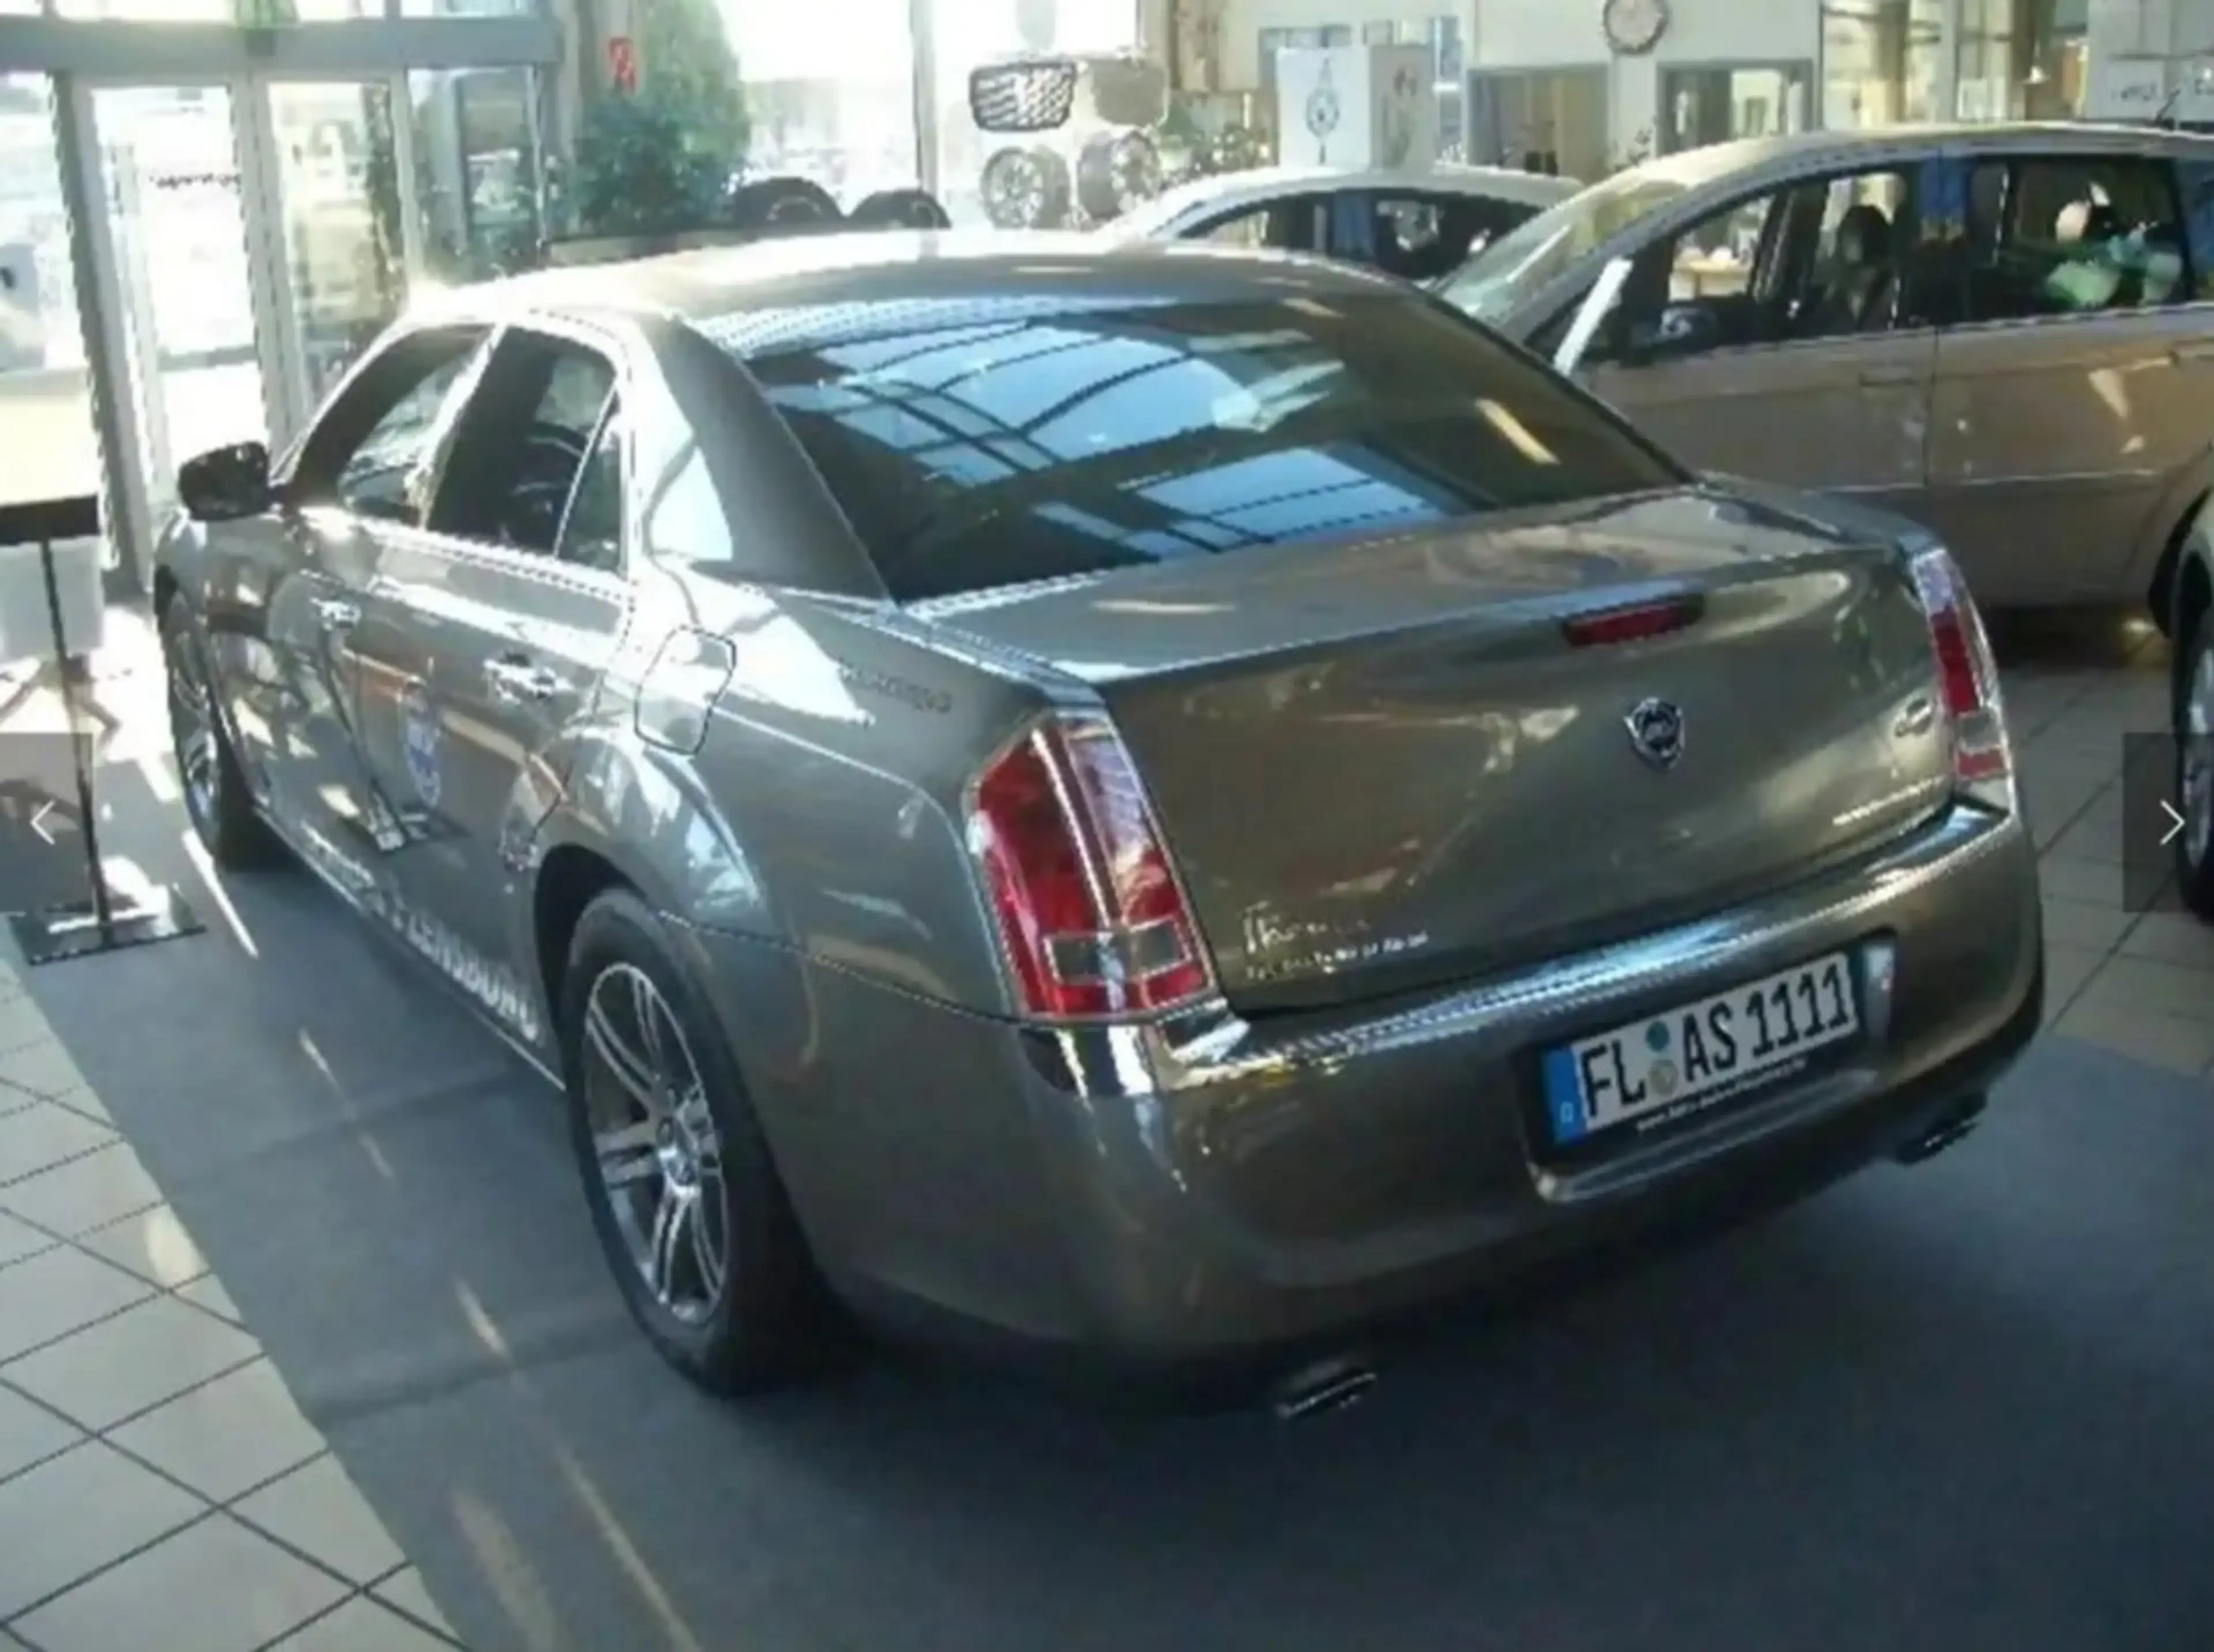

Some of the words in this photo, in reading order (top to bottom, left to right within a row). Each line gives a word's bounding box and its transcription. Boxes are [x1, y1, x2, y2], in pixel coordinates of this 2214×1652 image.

[1580, 1040, 1646, 1117] FL
[1682, 1000, 1737, 1082] AS
[1746, 962, 1848, 1058] 1111
